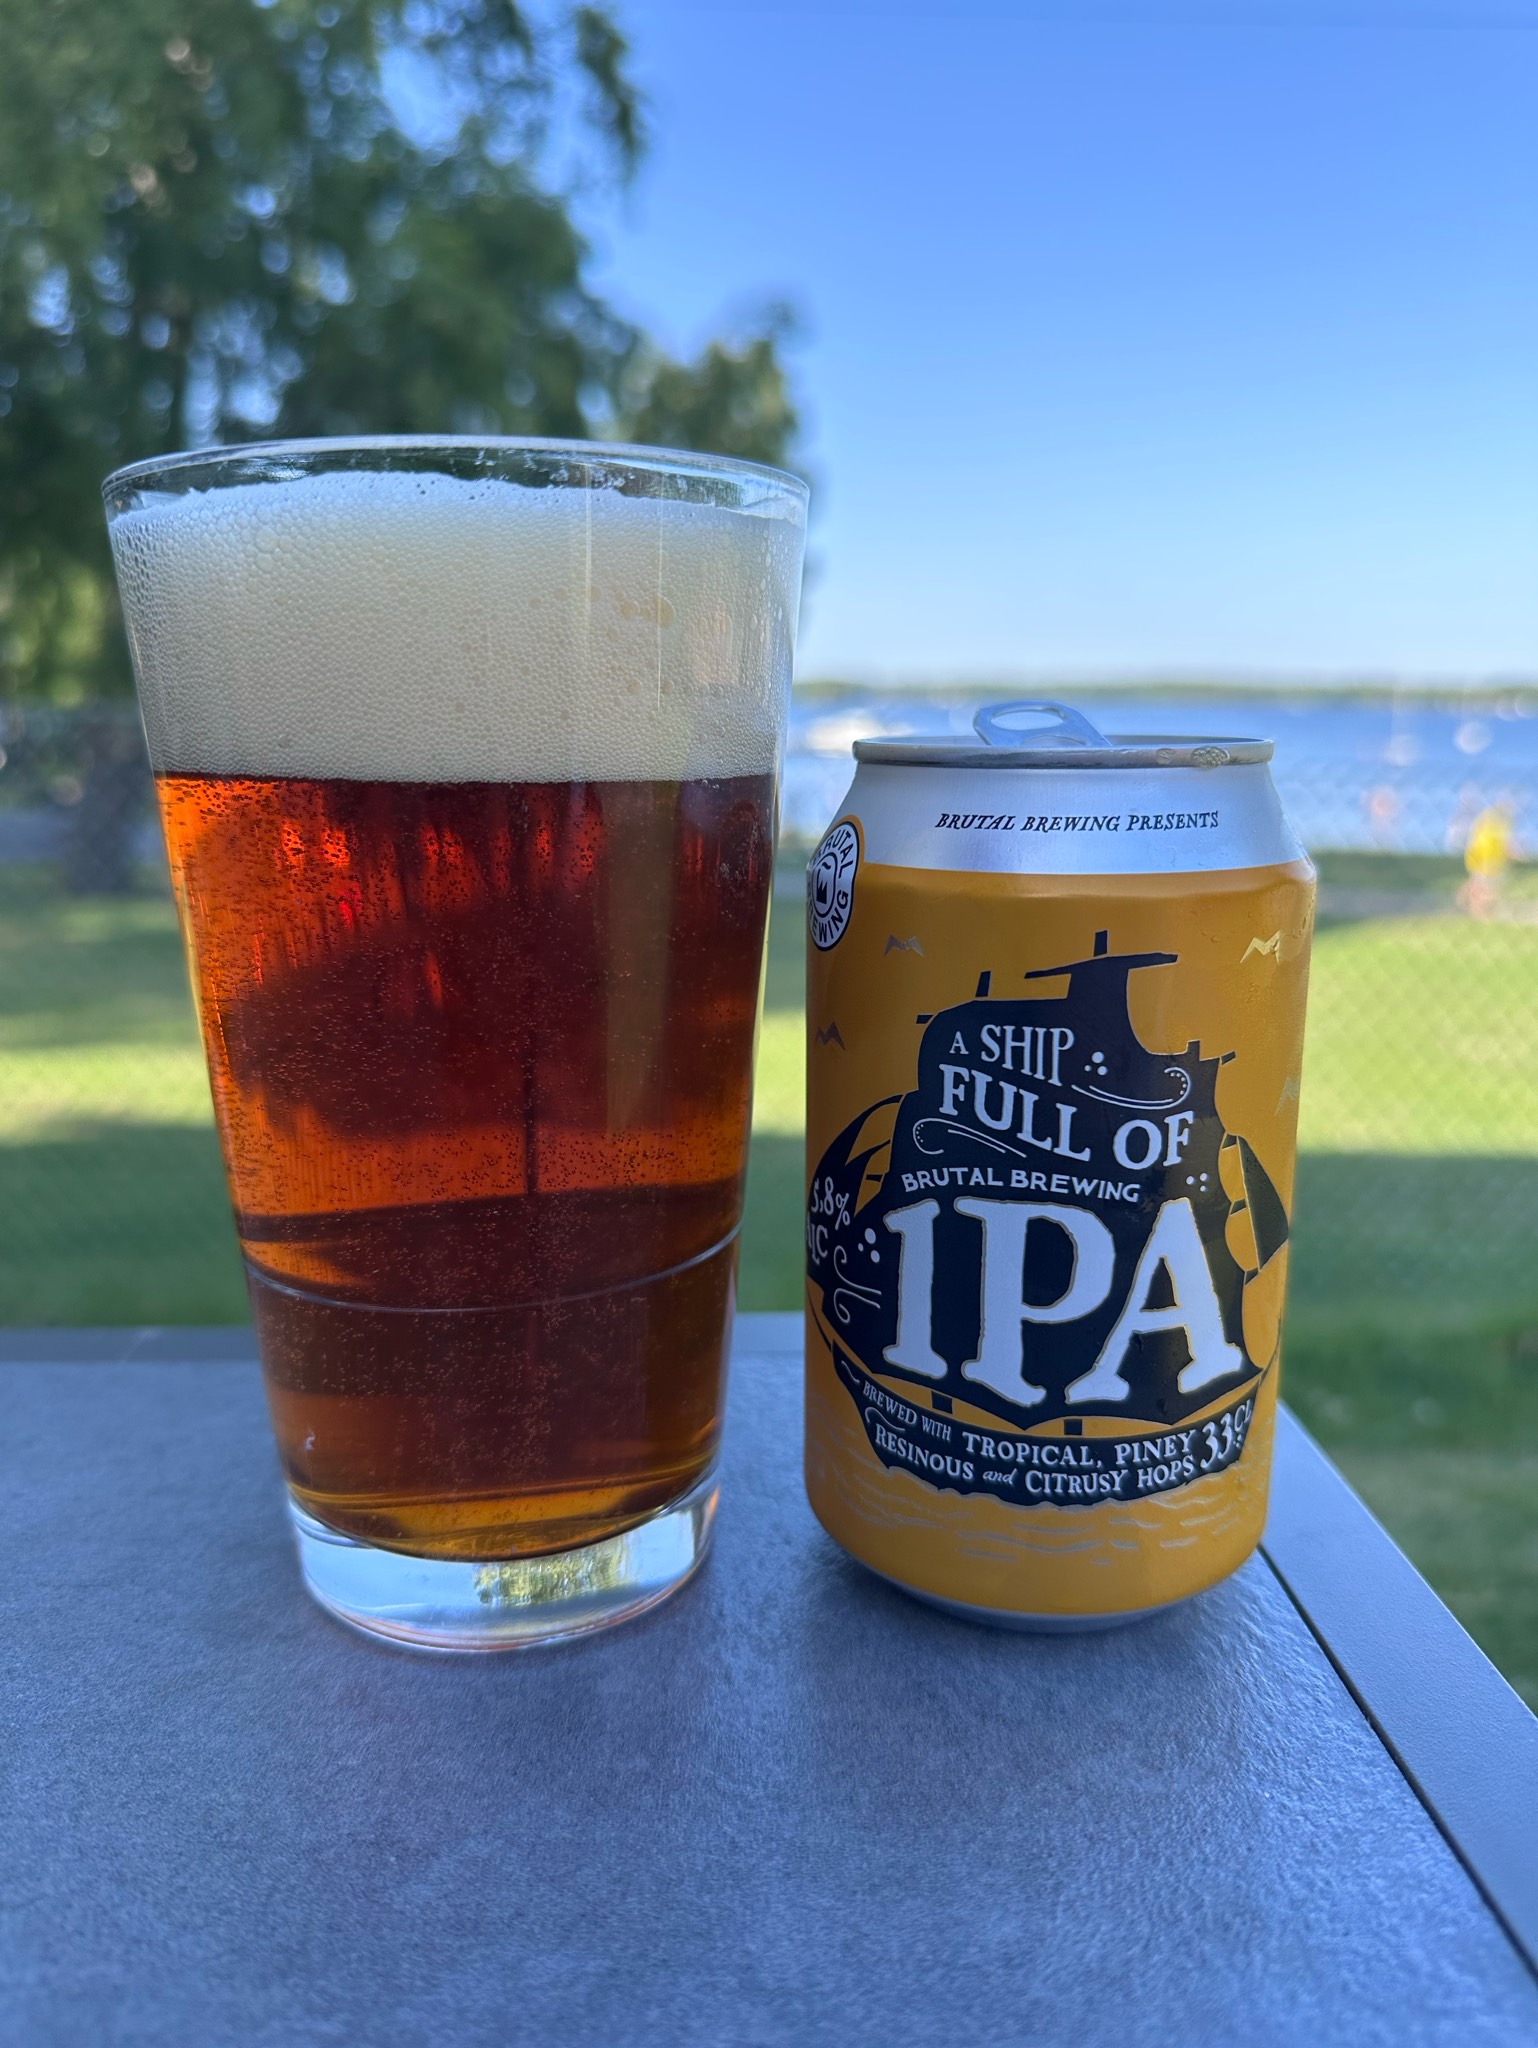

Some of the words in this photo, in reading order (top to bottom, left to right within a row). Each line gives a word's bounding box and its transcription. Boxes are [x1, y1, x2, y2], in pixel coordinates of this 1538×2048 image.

[935, 813, 1016, 830] BRUTAL
[1020, 815, 1121, 833] BREWING
[1126, 811, 1219, 832] PRESENTS
[949, 1031, 969, 1055] A
[980, 1024, 1075, 1086] SHIP
[938, 1063, 1091, 1162] FULL
[1112, 1110, 1194, 1170] OF
[901, 1167, 1004, 1192] BRUTAL
[1010, 1169, 1141, 1203] BREWING
[882, 1196, 1245, 1407] IPA
[863, 1380, 918, 1426] BREWED
[921, 1415, 952, 1441] WITH
[962, 1431, 1102, 1468] TROPICAL,
[1114, 1429, 1197, 1465] PINEY
[875, 1424, 974, 1481] RESINOUS
[982, 1468, 1018, 1485] and
[1024, 1469, 1129, 1494] CITRUSY
[1137, 1454, 1194, 1488] HOPS
